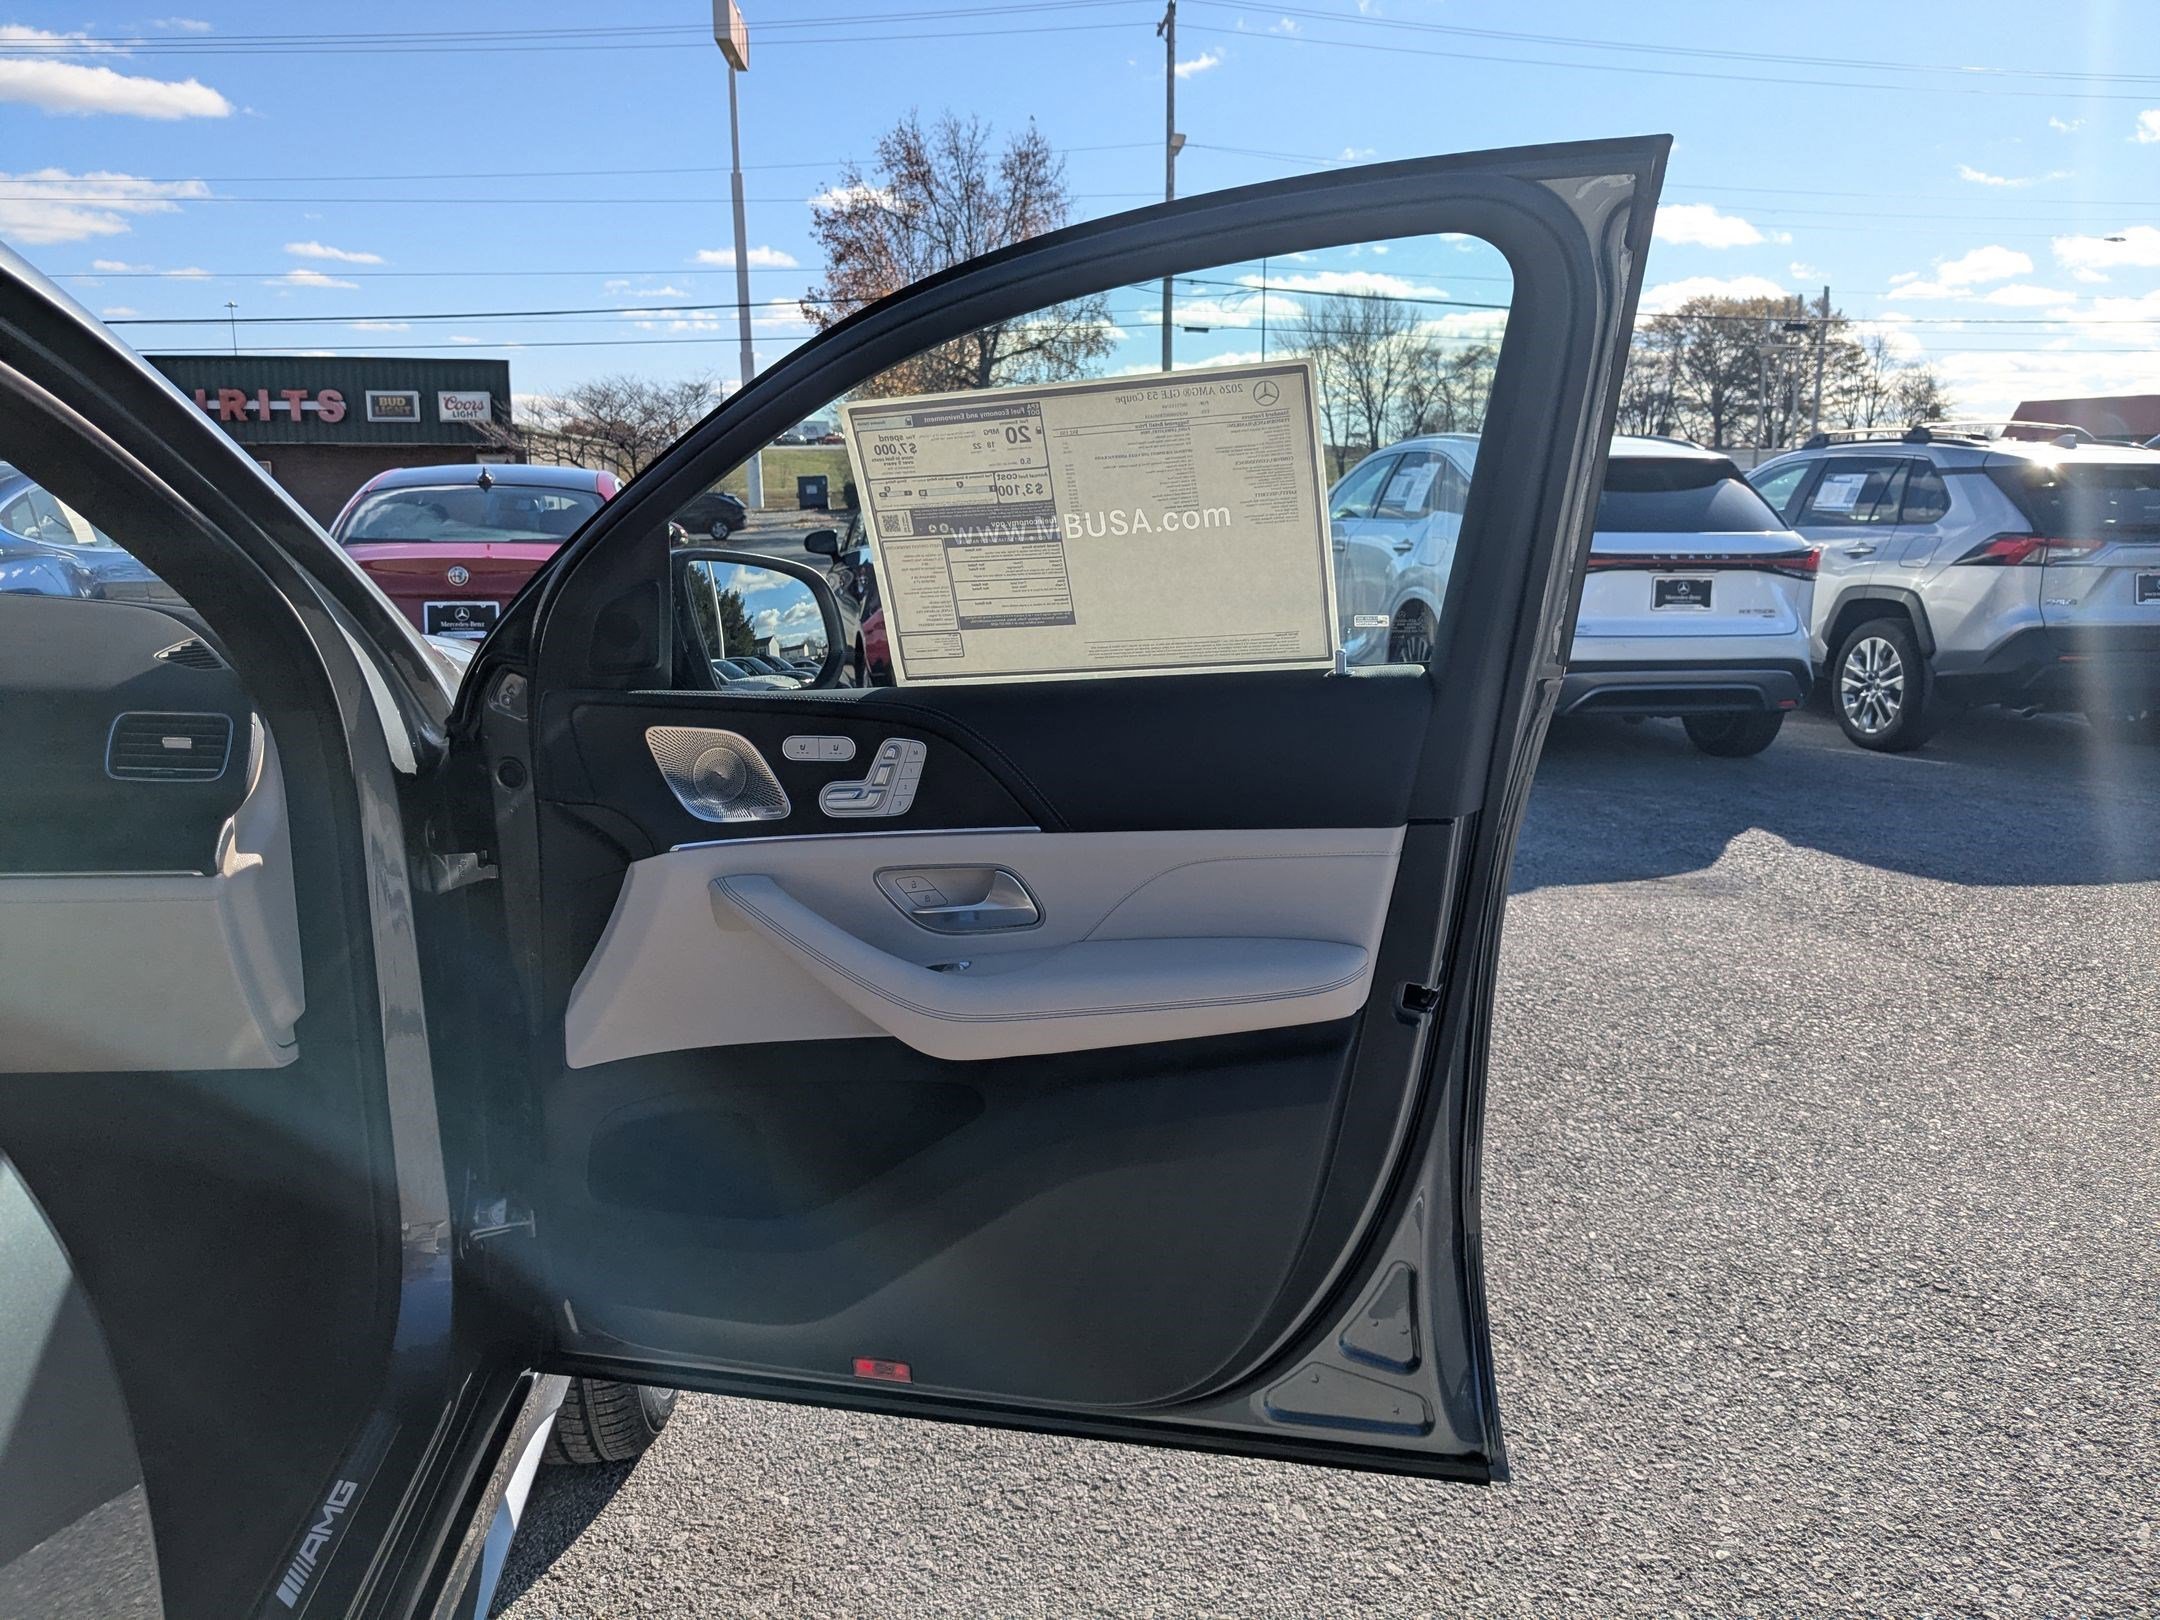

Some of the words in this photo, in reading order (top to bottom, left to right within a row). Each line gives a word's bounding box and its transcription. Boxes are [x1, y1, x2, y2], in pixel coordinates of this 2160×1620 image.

[378, 397, 406, 407] BUD
[443, 395, 485, 411] Coors
[452, 410, 479, 418] LIGHT
[949, 506, 1231, 545] www.MBUSA.com
[441, 621, 485, 629] Mercedes-Benz
[299, 1480, 358, 1566] AMG
